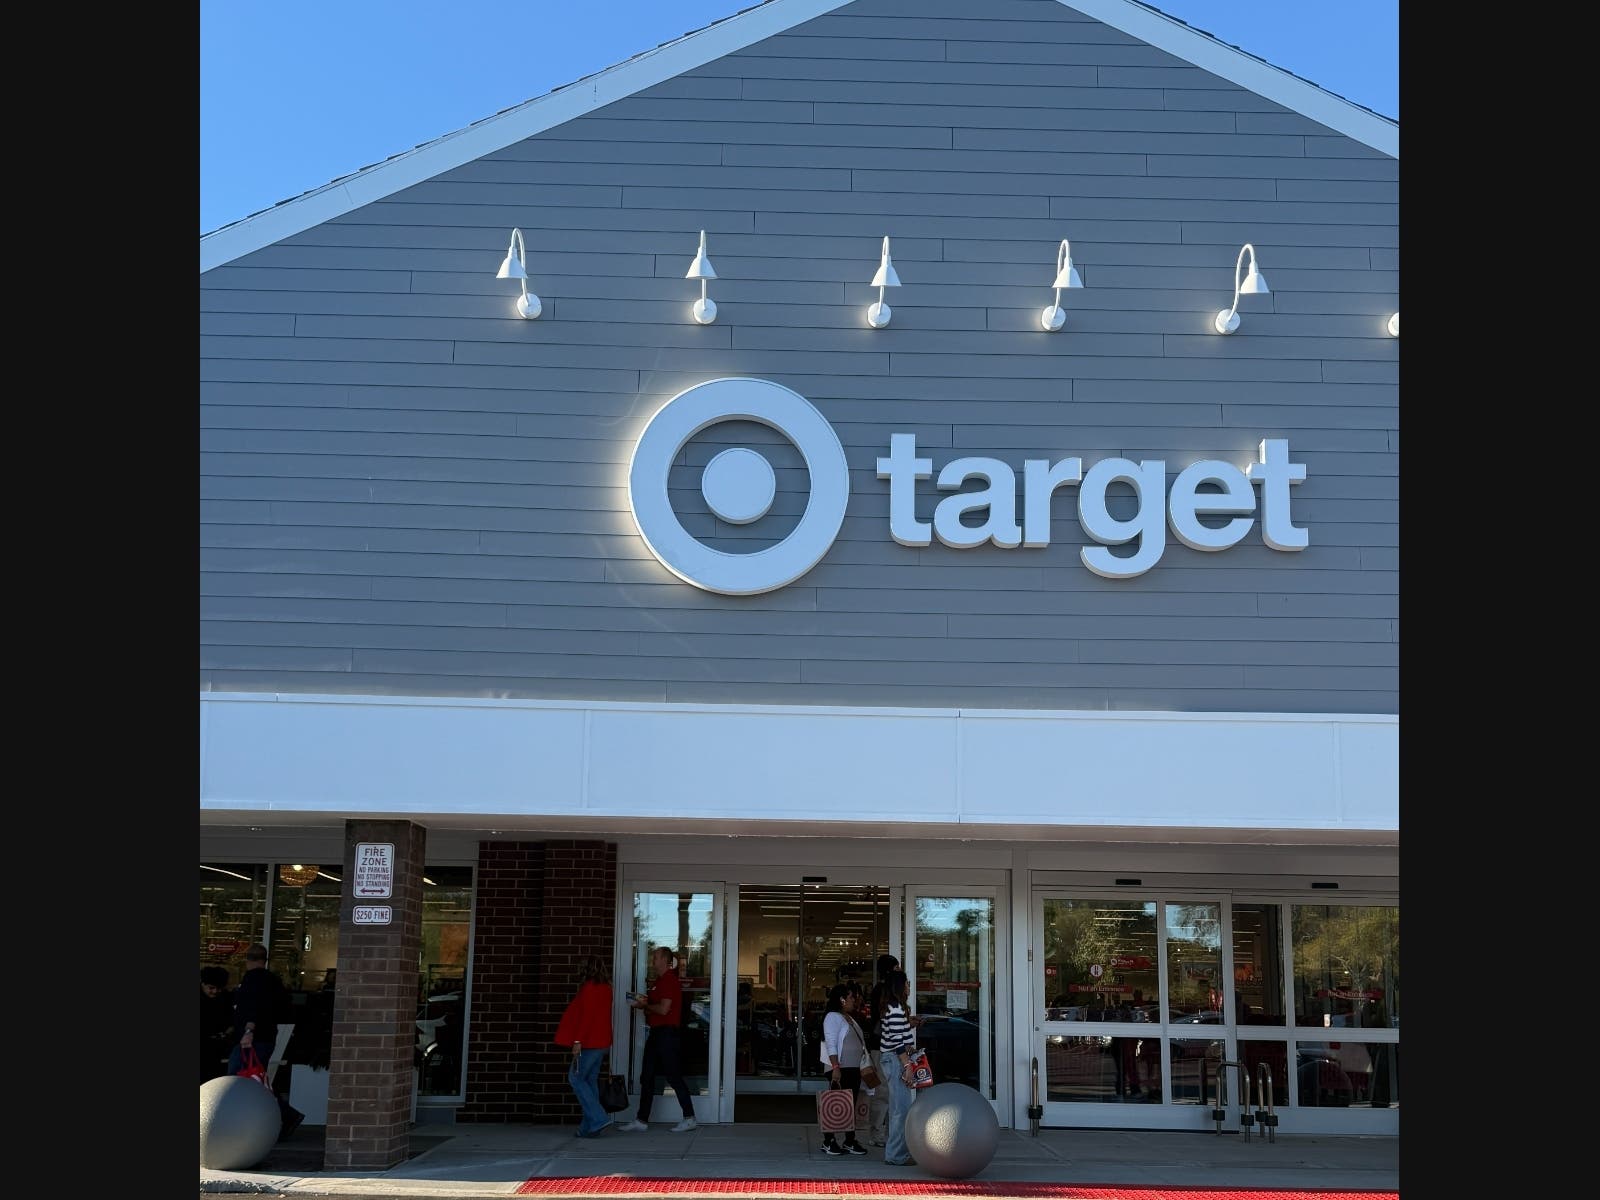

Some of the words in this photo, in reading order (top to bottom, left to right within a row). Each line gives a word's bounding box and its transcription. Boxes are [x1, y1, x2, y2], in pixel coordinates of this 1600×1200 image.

[877, 433, 1309, 579] target
[364, 848, 386, 857] FIRE
[361, 857, 388, 866] ZONE
[356, 910, 373, 920] $250
[374, 910, 389, 920] FINE
